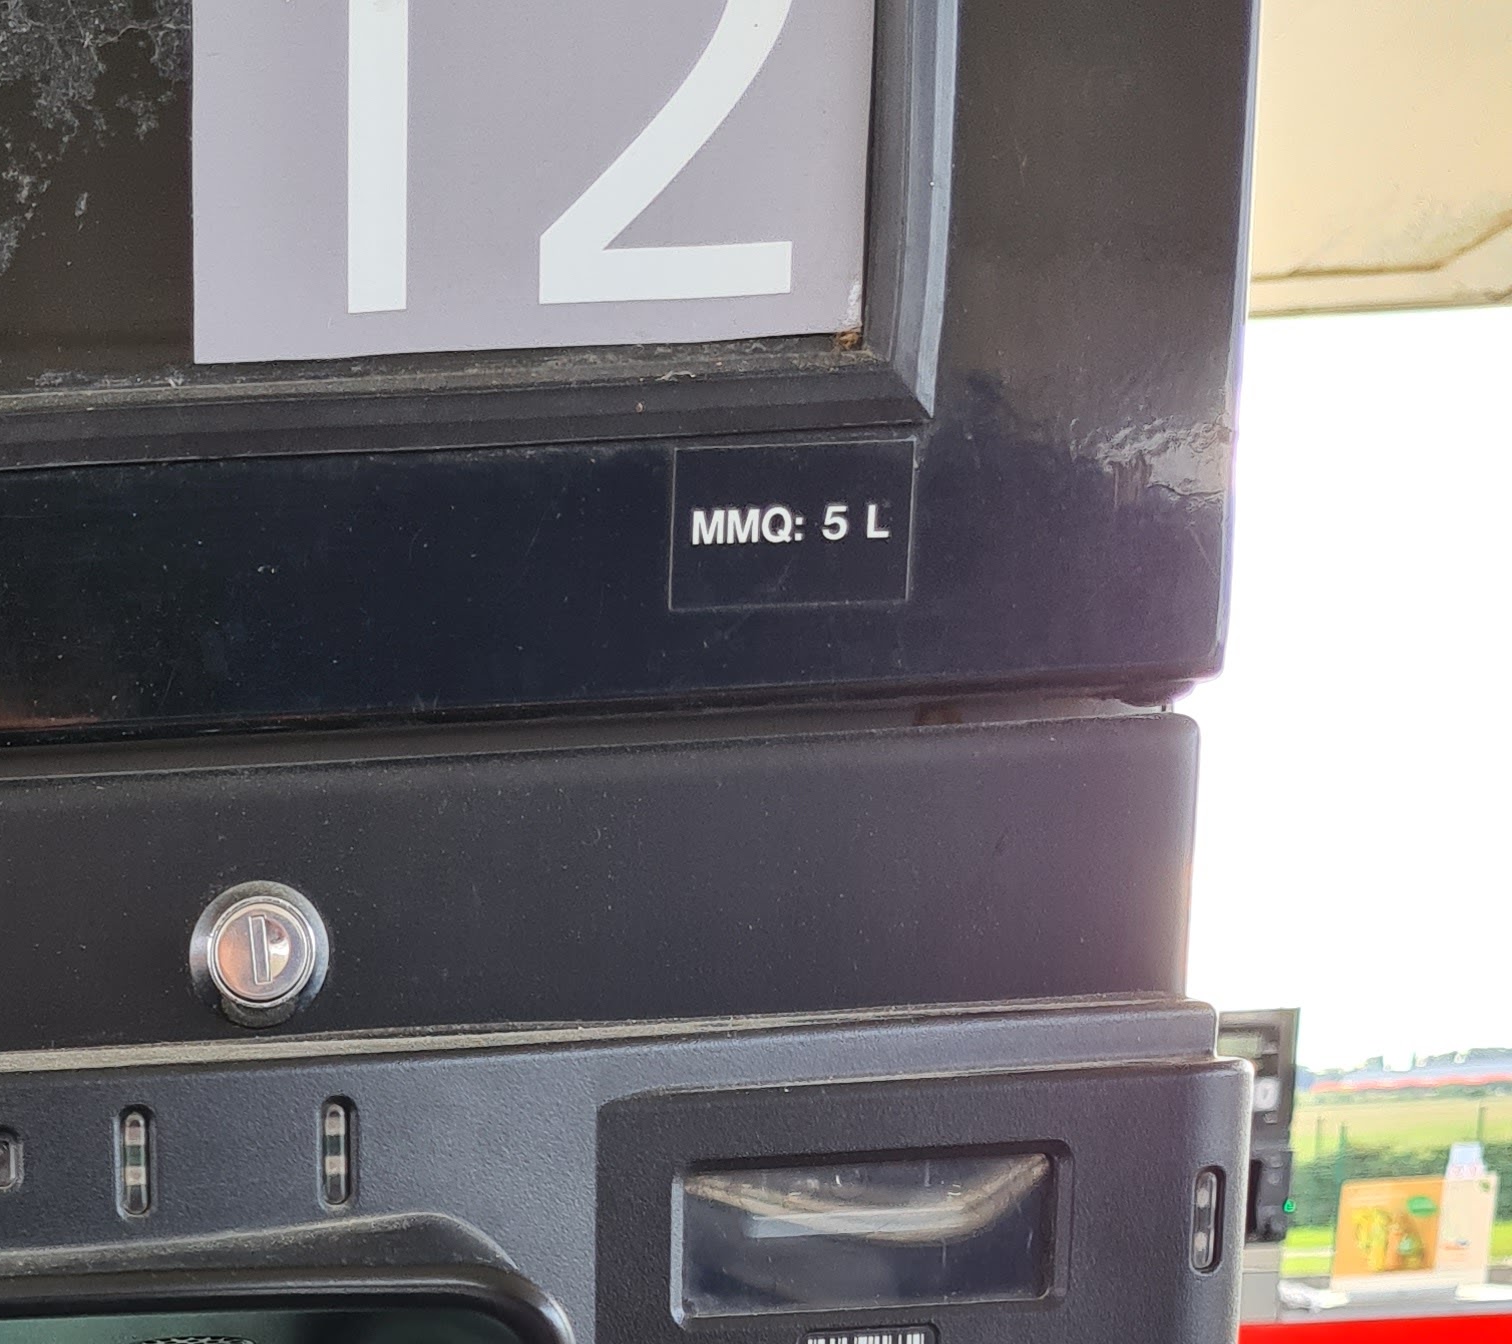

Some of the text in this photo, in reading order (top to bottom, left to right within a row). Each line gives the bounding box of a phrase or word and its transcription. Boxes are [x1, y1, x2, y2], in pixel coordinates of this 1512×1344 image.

[347, 0, 792, 314] 12
[691, 504, 890, 546] MMQ: 5 L
